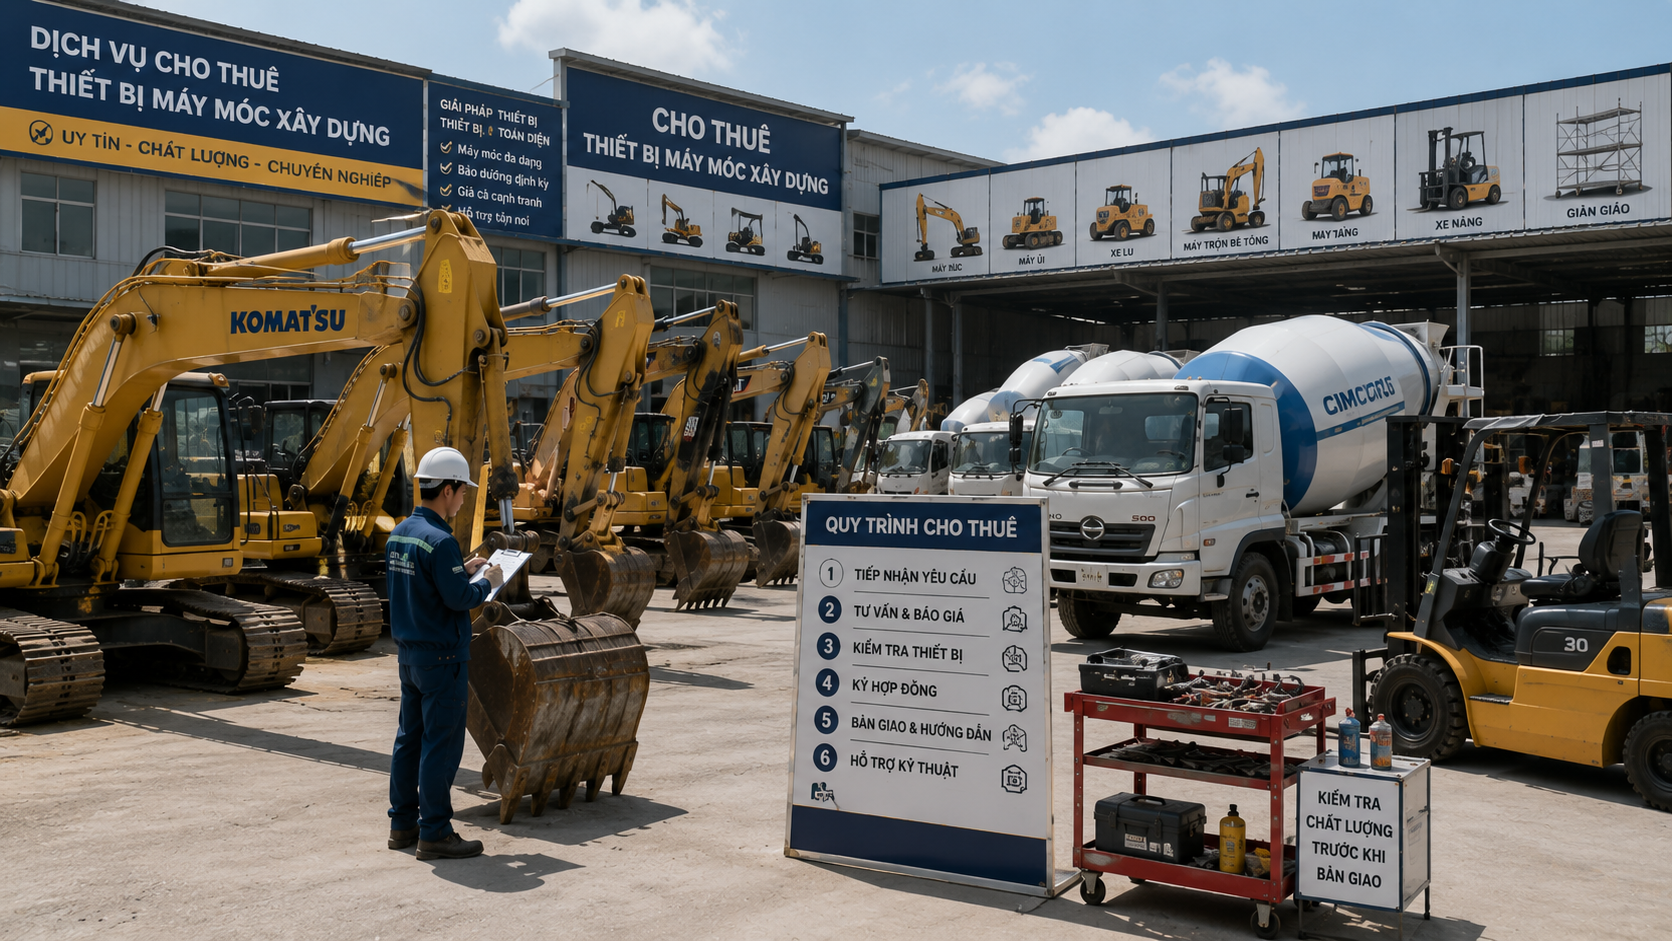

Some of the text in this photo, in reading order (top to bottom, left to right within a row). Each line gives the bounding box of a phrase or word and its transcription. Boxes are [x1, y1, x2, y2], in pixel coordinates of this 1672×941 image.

[31, 25, 279, 92] DỊCH VỤ CHO THUÊ
[29, 66, 390, 147] THIẾT BỊ MÁY MÓC XÂY DỰNG
[62, 129, 87, 146] UY
[652, 107, 770, 154] CHO THUÊ
[583, 132, 829, 195] THIẾT BỊ MÁY MÓC XÂY DỰNG
[517, 195, 542, 208] tranh
[1435, 220, 1449, 230] XE
[1111, 248, 1134, 257] XE LU
[826, 513, 1017, 538] QUY TRÌNH CHO THUÊ
[827, 566, 834, 581] 1
[884, 567, 919, 585] NHẬN
[825, 602, 835, 617] 2
[854, 604, 871, 618] TƯ
[901, 607, 910, 620] &
[914, 605, 940, 621] BÁO
[943, 608, 965, 623] GIÁ
[824, 638, 834, 654] 3
[885, 643, 909, 657] TRA
[951, 648, 963, 664] BỊ
[1564, 636, 1588, 652] 30
[822, 675, 832, 691] 4
[872, 680, 897, 696] HỢP
[821, 712, 831, 728] 5
[878, 719, 906, 733] GIAO
[909, 722, 917, 734] &
[820, 750, 830, 765] 6
[871, 756, 895, 773] TRỢ
[918, 761, 959, 780] THUẬT
[1354, 795, 1381, 811] TRA
[1363, 847, 1385, 863] KHI
[1348, 872, 1381, 888] GIAO
